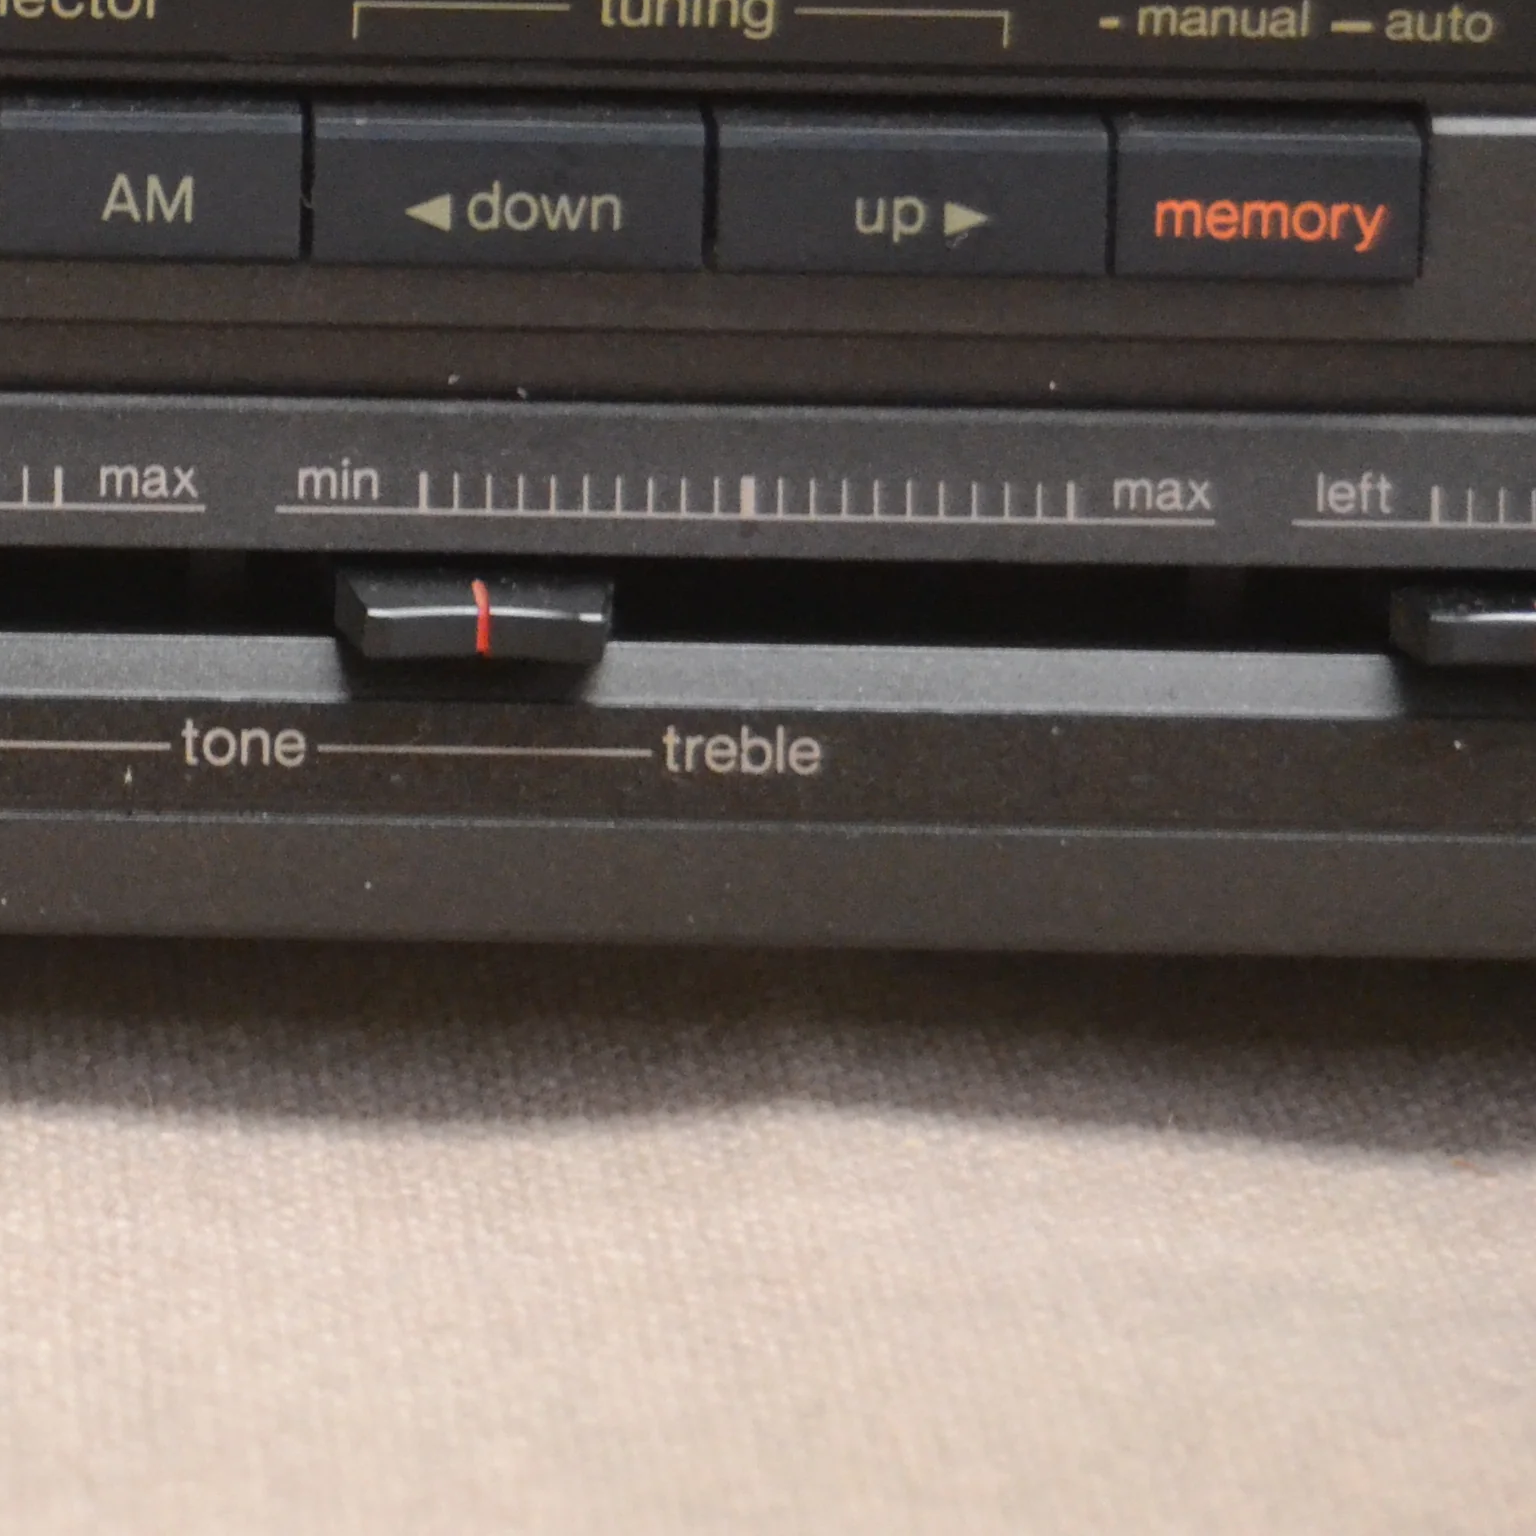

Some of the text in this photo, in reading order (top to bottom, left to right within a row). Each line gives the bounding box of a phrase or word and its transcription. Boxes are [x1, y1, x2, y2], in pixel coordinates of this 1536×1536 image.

[1384, 7, 1495, 45] auto
[101, 173, 194, 223] AM
[466, 182, 623, 234] down
[854, 195, 927, 245] up
[1153, 197, 1386, 253] memory
[98, 463, 199, 499] max
[297, 458, 381, 499] min
[1112, 478, 1212, 512] max
[1316, 472, 1394, 514] left
[181, 717, 307, 768] tone
[661, 727, 823, 774] treble
